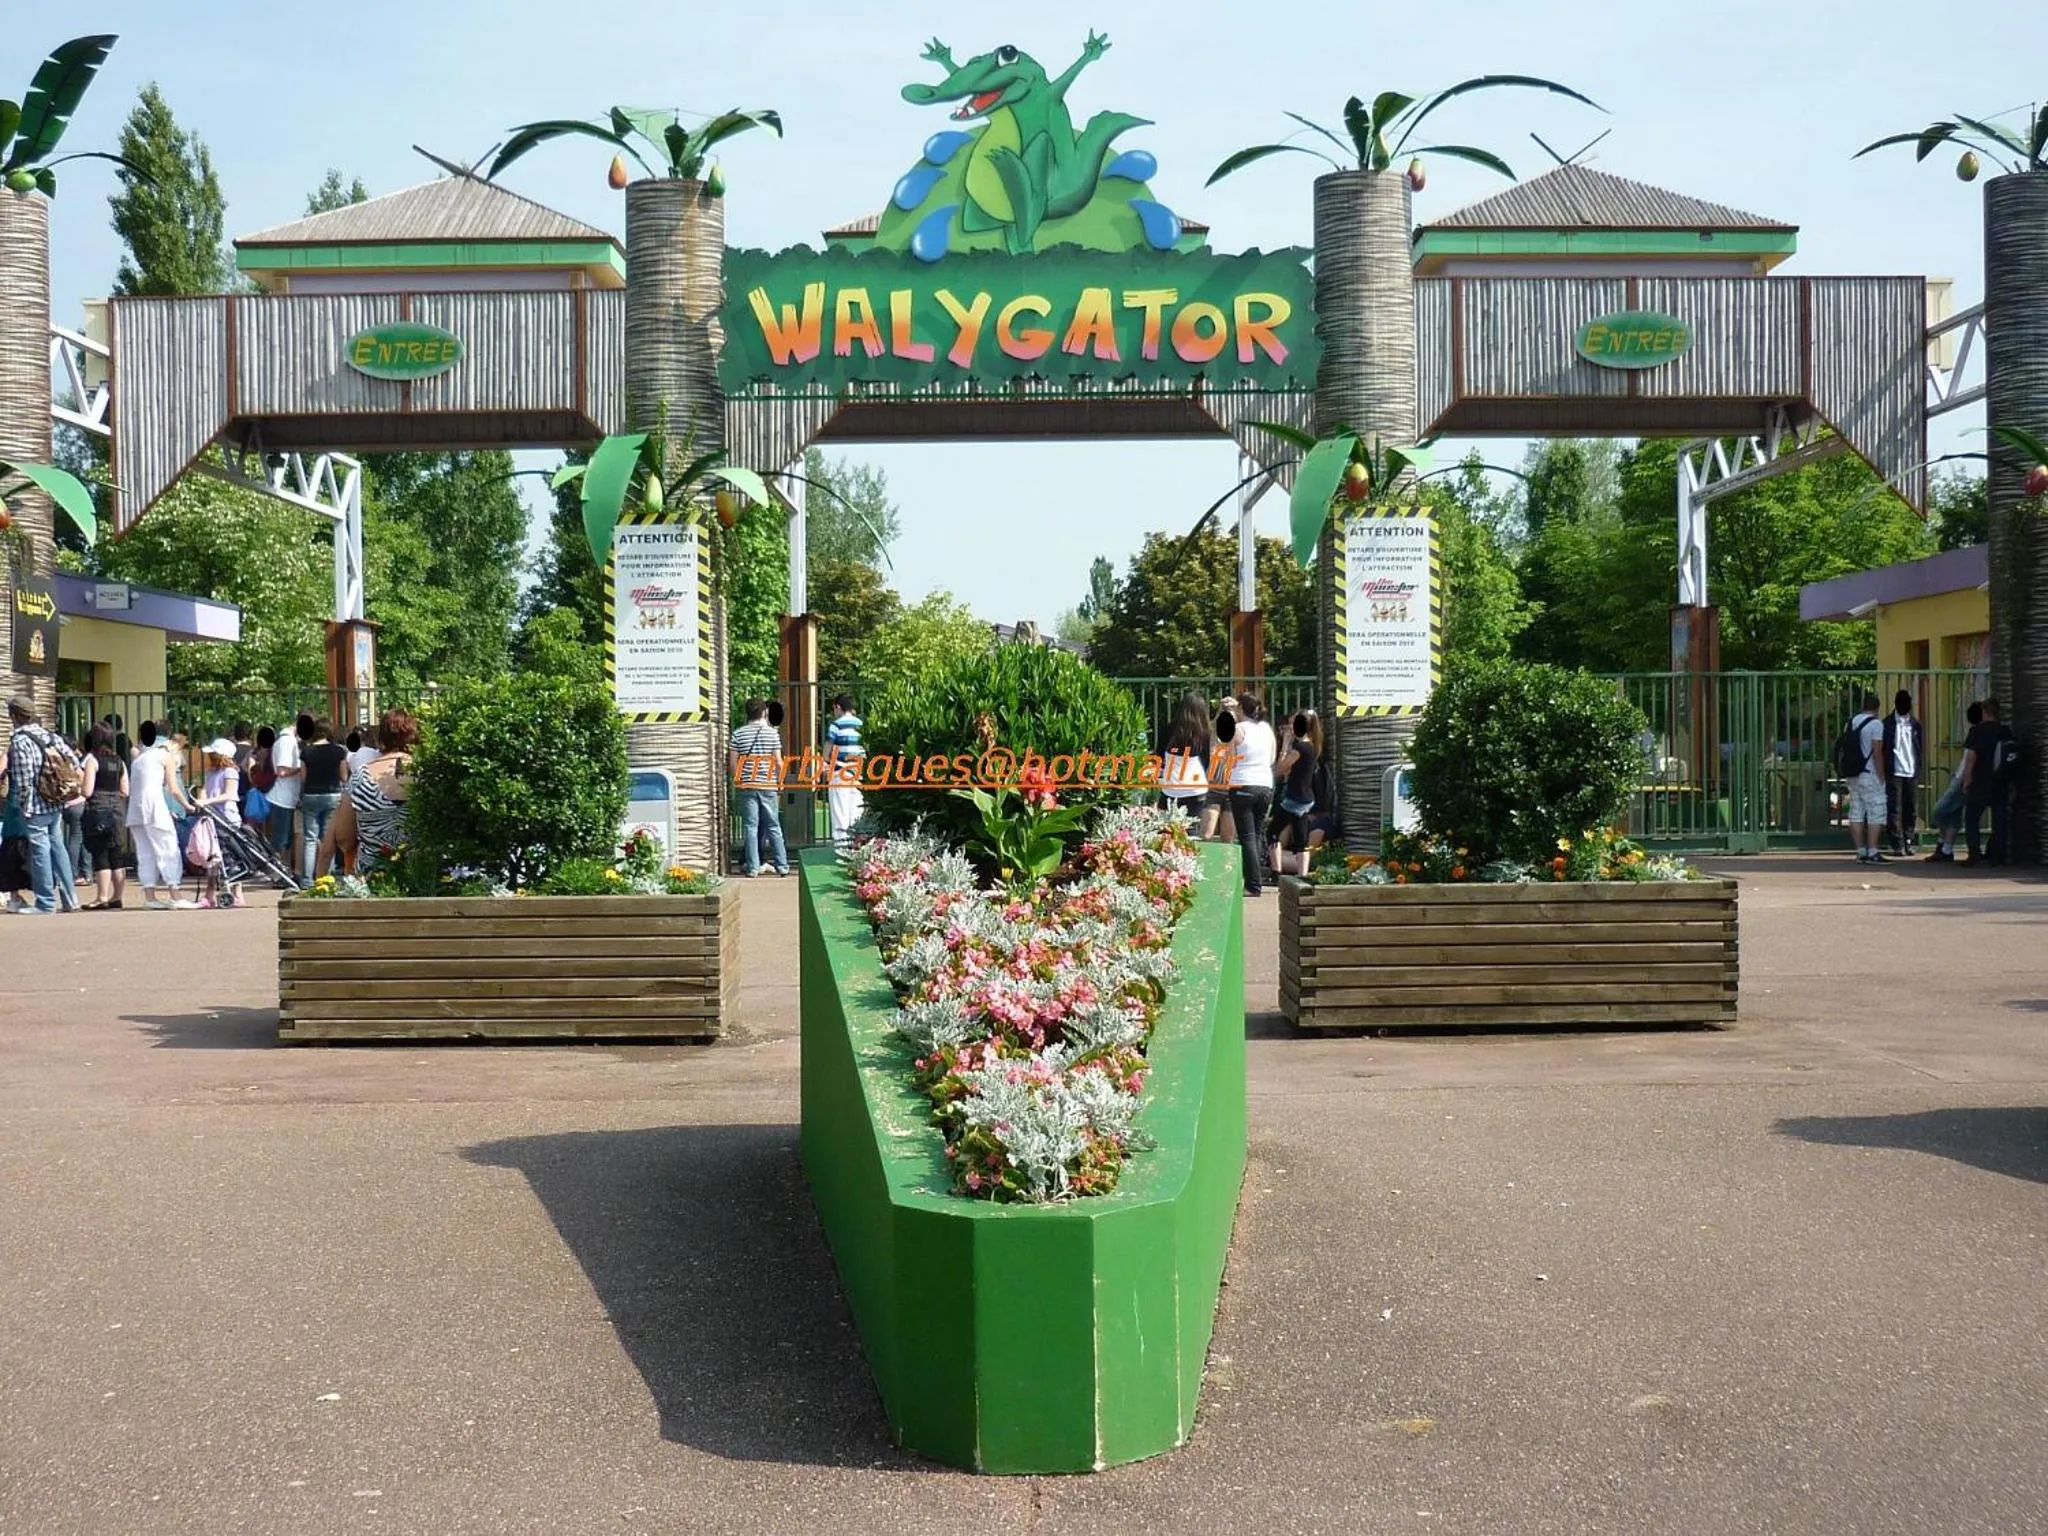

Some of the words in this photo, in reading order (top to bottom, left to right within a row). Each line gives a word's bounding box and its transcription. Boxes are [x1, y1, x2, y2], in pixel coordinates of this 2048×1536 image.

[747, 281, 1292, 368] WALYGATOR
[1350, 527, 1424, 537] ATTENTION
[619, 533, 693, 544] ATTENTION
